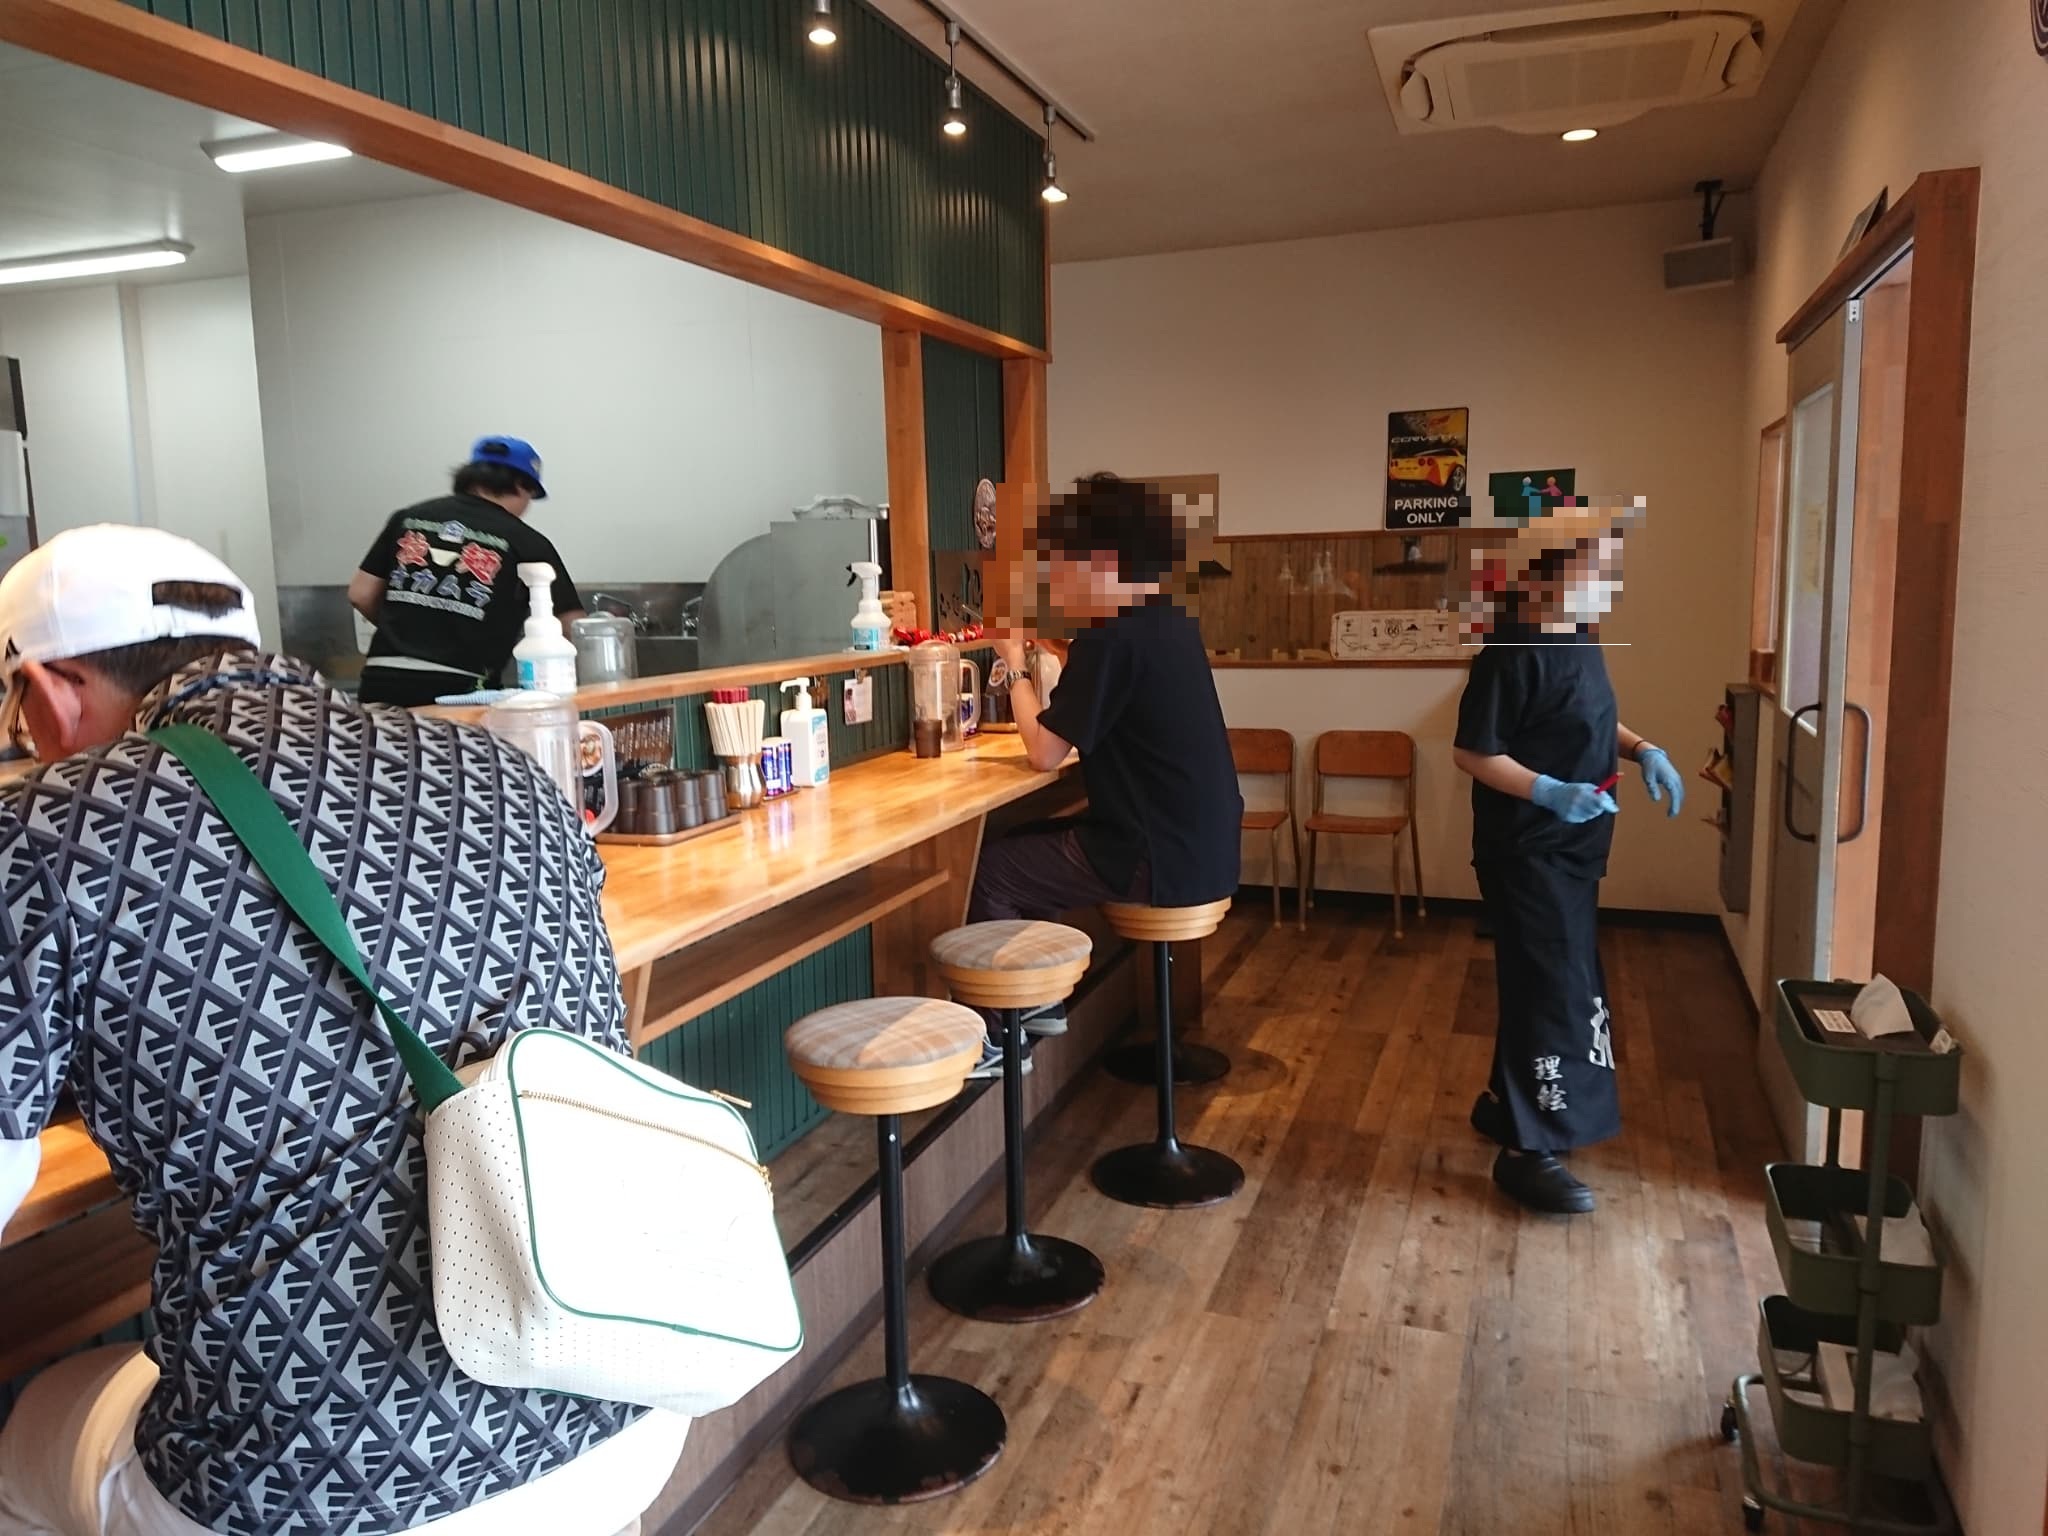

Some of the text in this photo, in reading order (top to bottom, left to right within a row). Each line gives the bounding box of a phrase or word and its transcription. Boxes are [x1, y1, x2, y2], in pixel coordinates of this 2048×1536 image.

[1394, 496, 1458, 511] PARKING
[1406, 512, 1446, 524] ONLY
[1386, 624, 1400, 636] 66
[1533, 1055, 1568, 1111] 理絵
